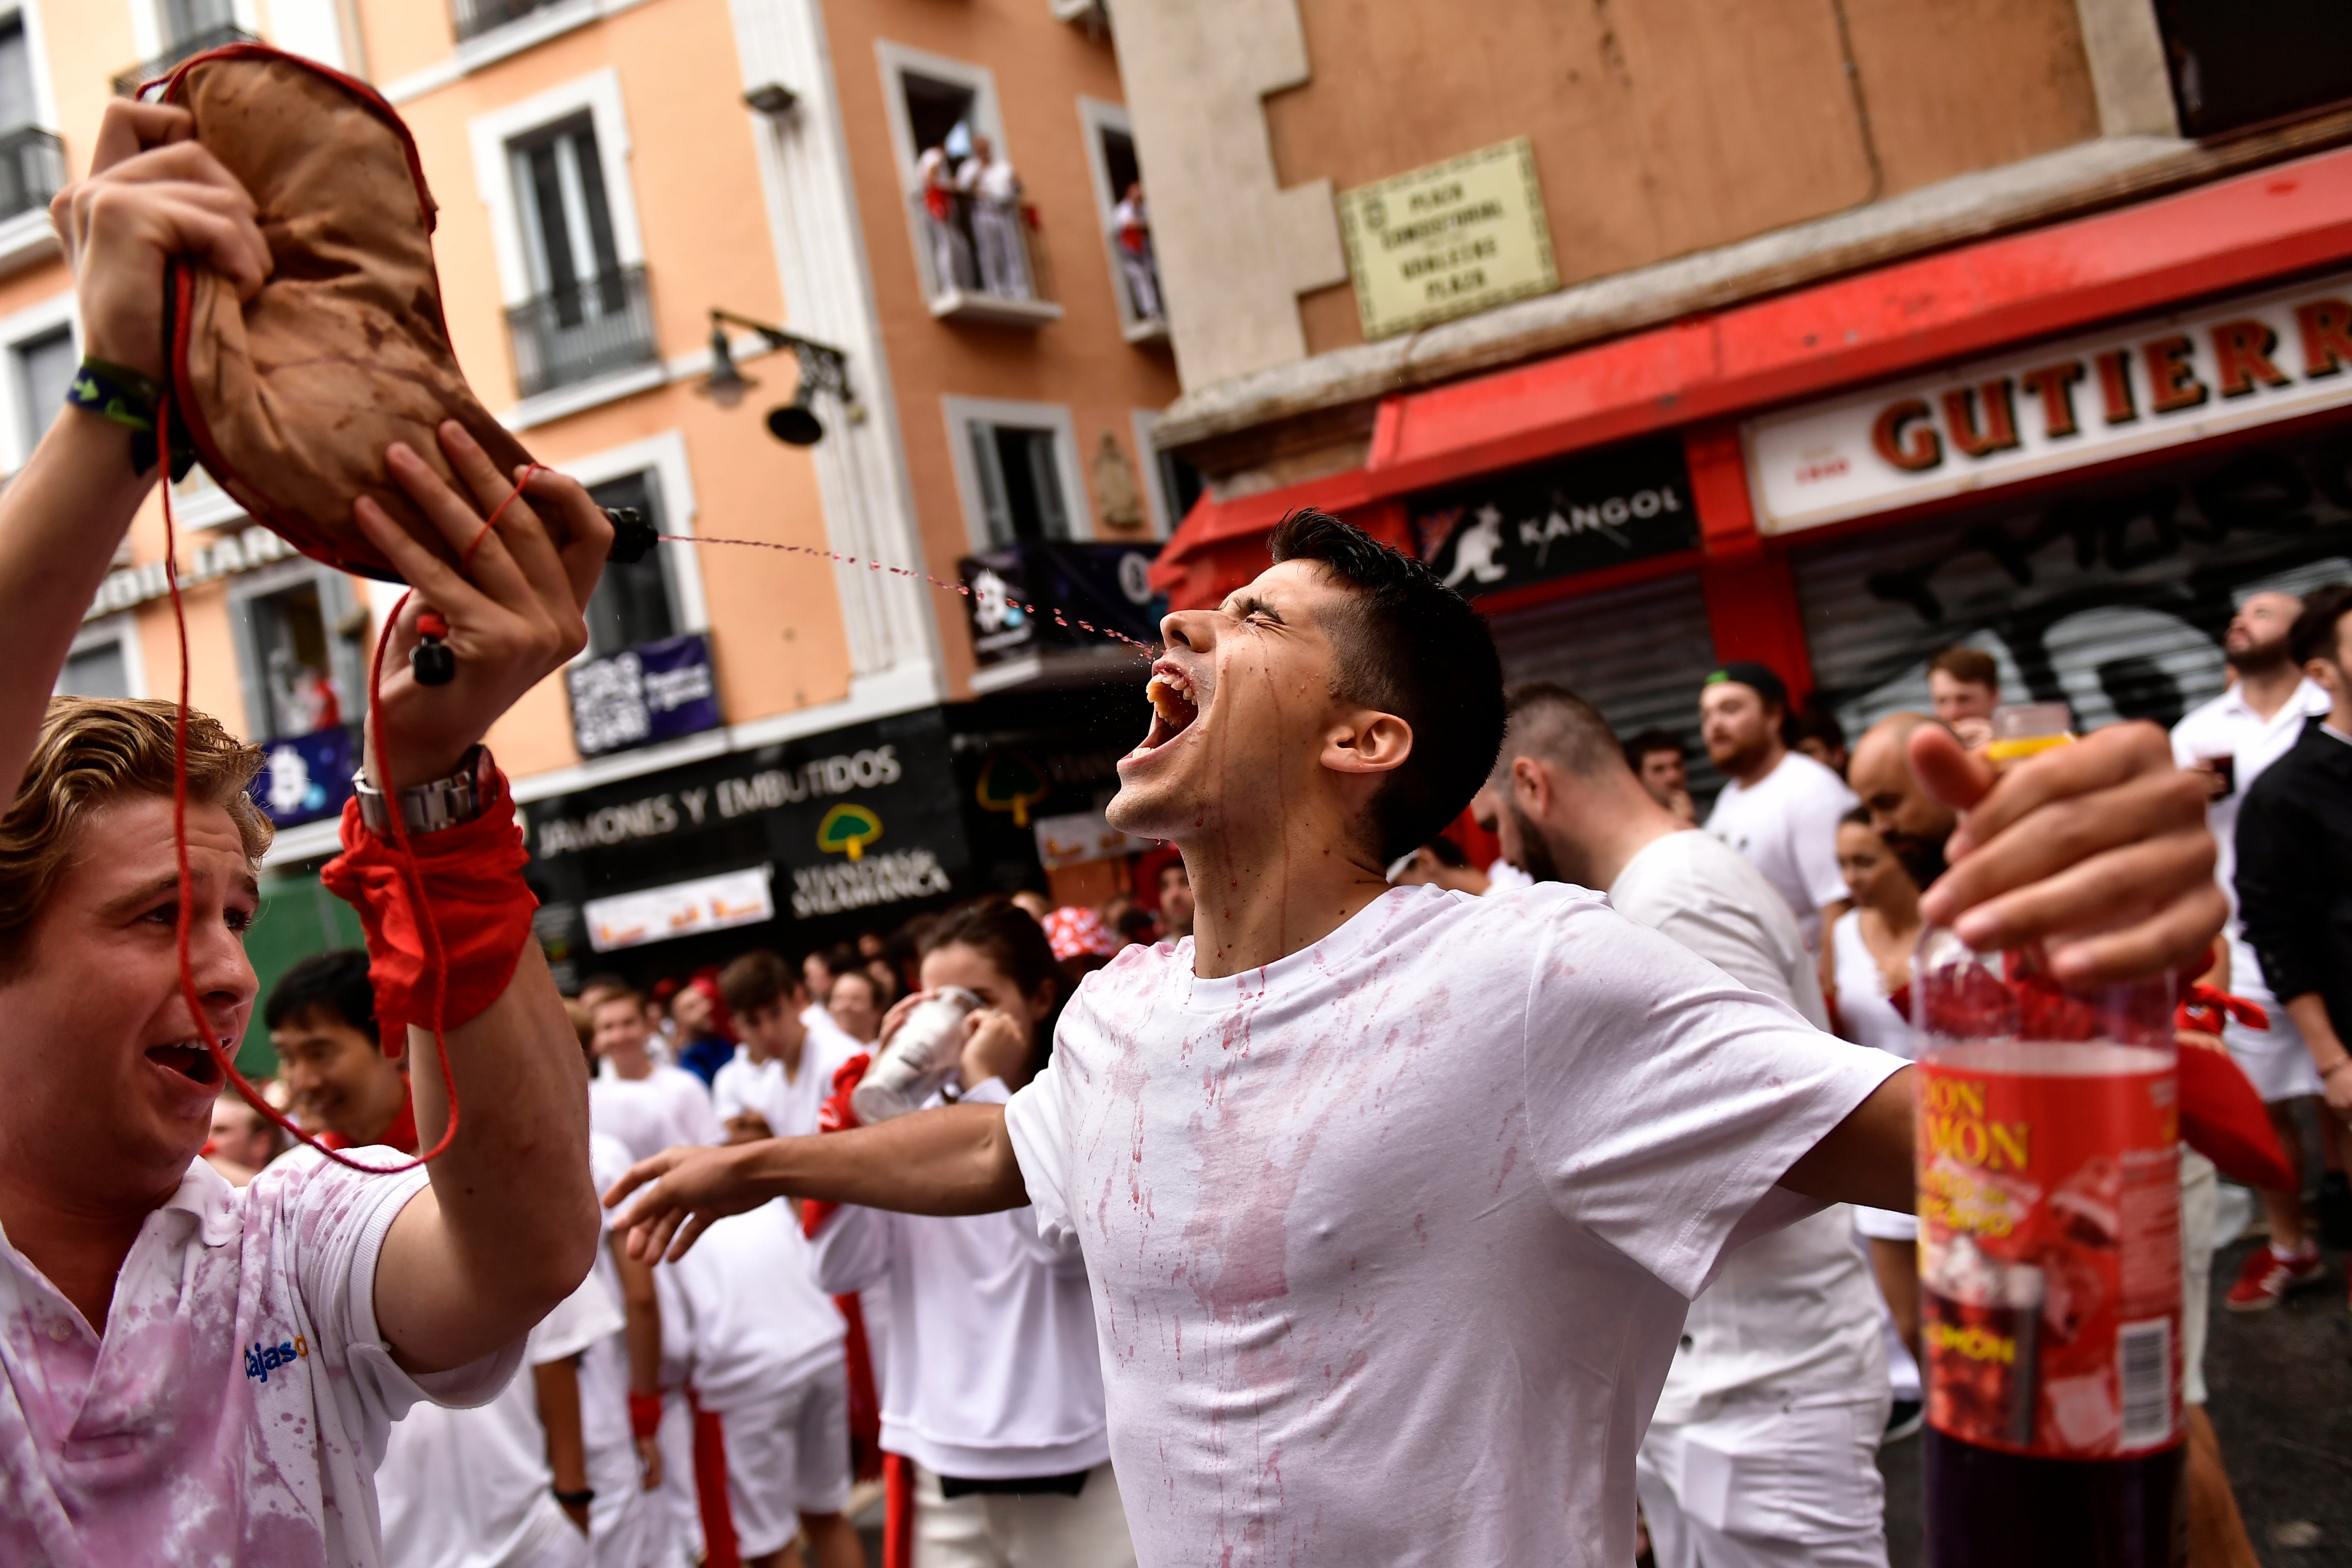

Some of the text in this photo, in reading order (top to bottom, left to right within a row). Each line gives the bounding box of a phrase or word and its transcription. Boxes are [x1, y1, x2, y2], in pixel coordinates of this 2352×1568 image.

[1520, 486, 1682, 545] KANGOL
[538, 745, 902, 859] JAMONES Y EMBUTIDOS
